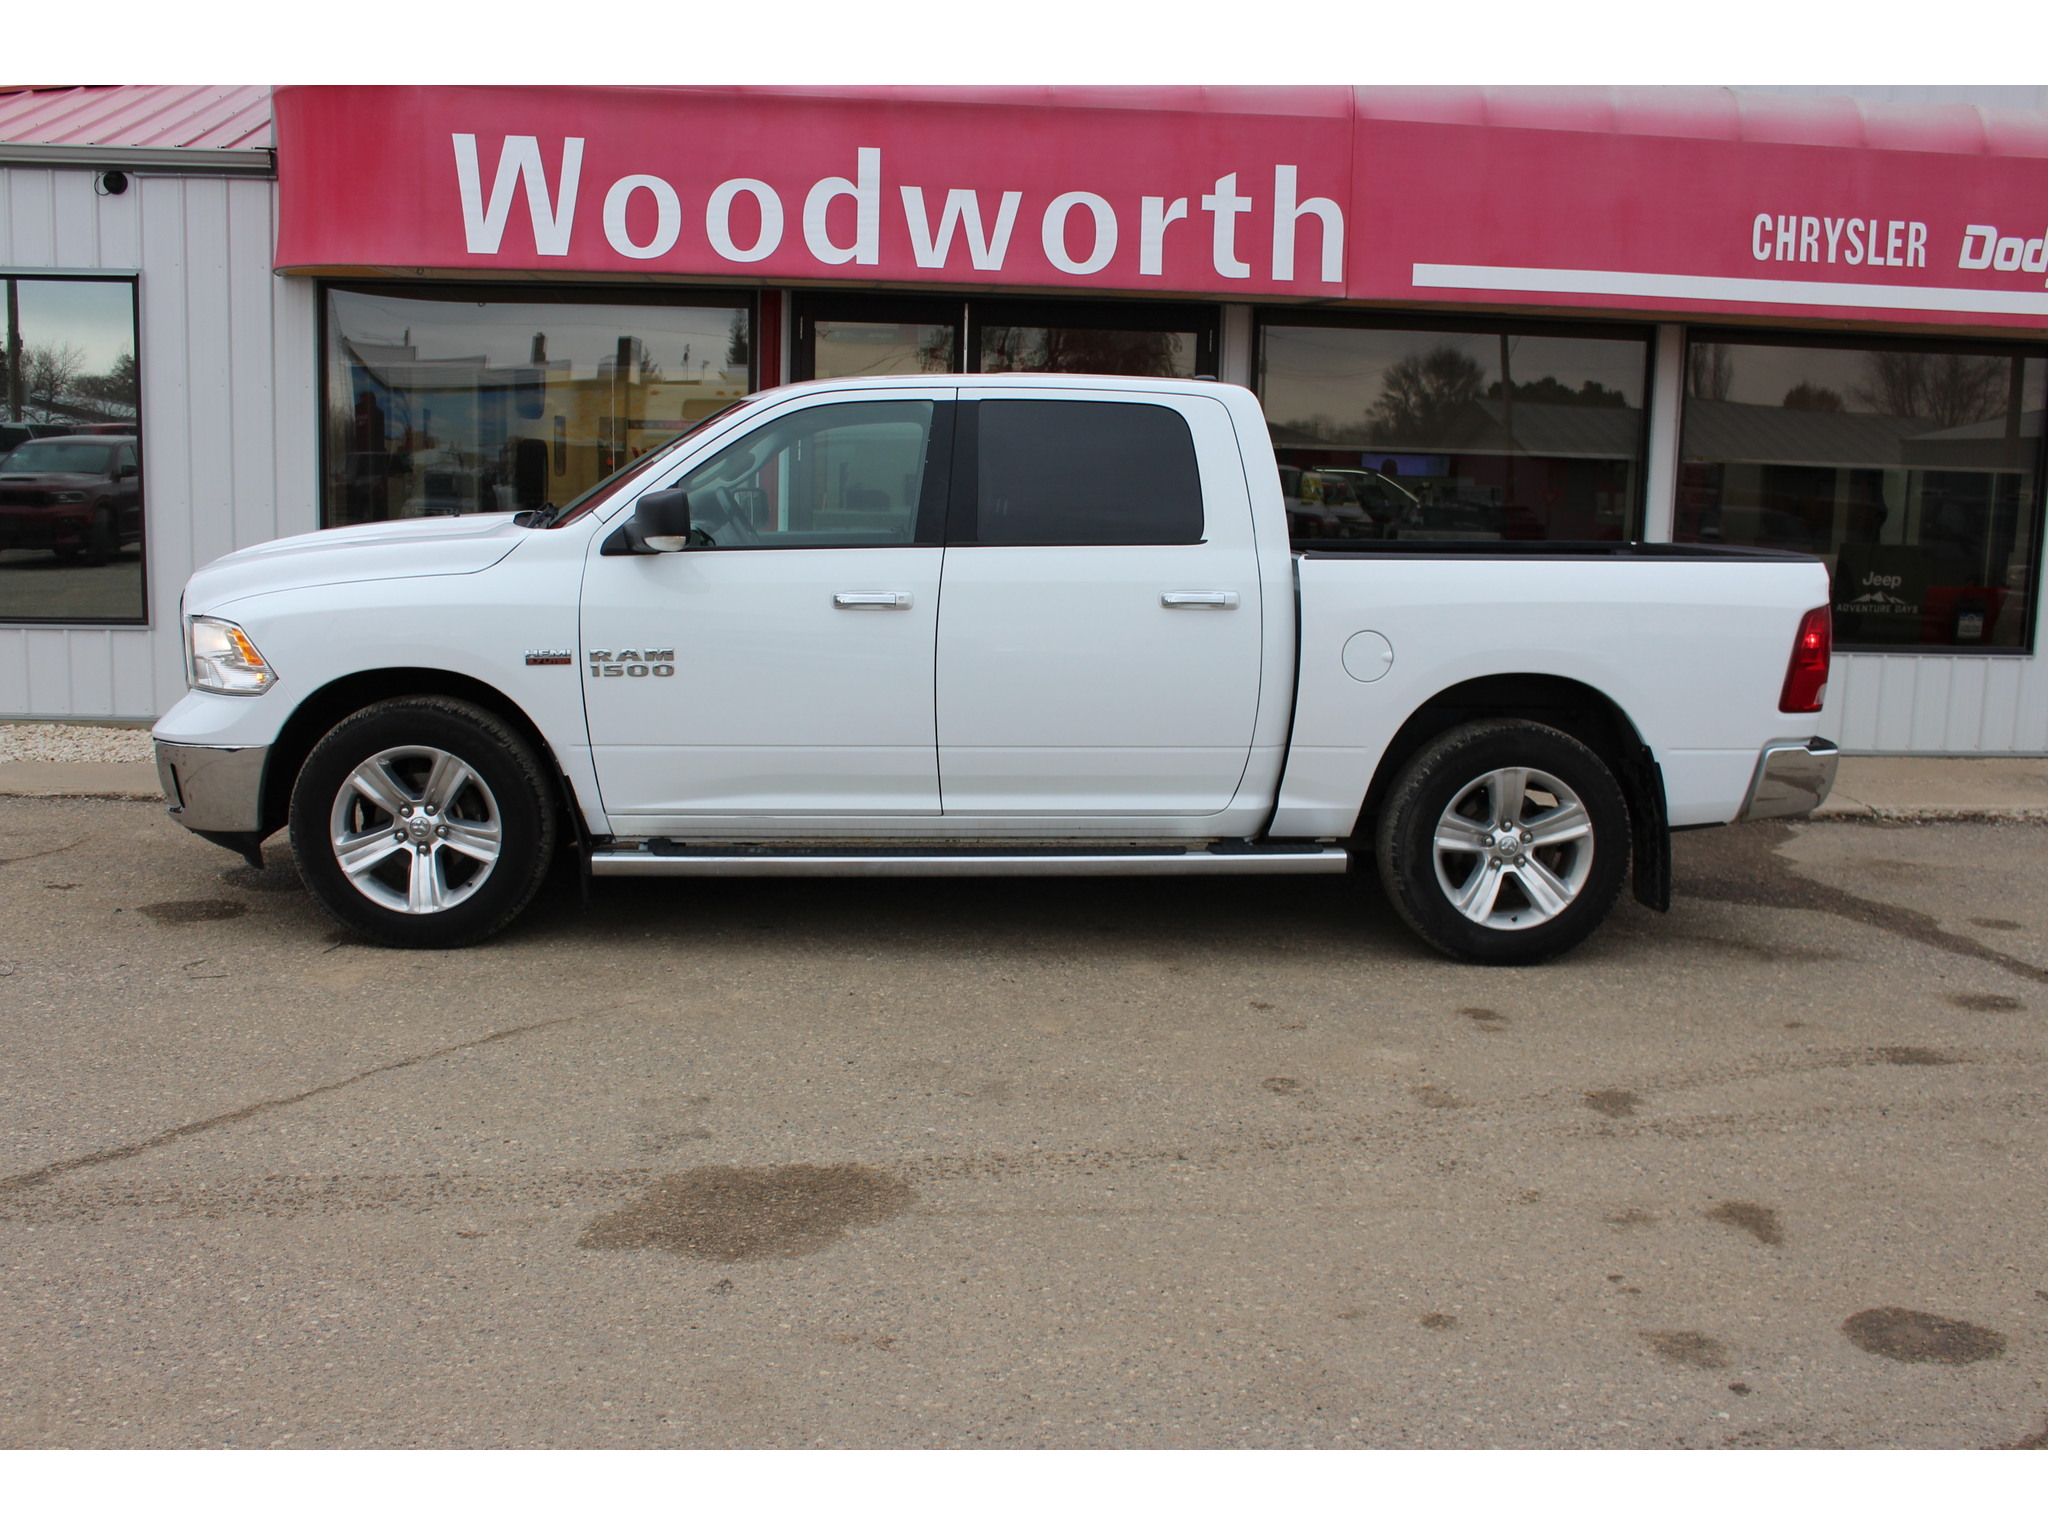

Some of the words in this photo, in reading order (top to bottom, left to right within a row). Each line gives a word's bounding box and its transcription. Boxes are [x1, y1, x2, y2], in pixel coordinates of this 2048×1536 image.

[451, 132, 1345, 284] Woodworth
[1752, 213, 1927, 268] CHRYSLER
[1958, 224, 2048, 289] Dod
[1862, 571, 1902, 589] Jeep
[1836, 603, 1891, 614] ADVENTURE
[1894, 604, 1919, 614] DAYS
[524, 648, 572, 657] HEMI
[589, 648, 675, 662] RAM
[590, 663, 675, 678] 1500
